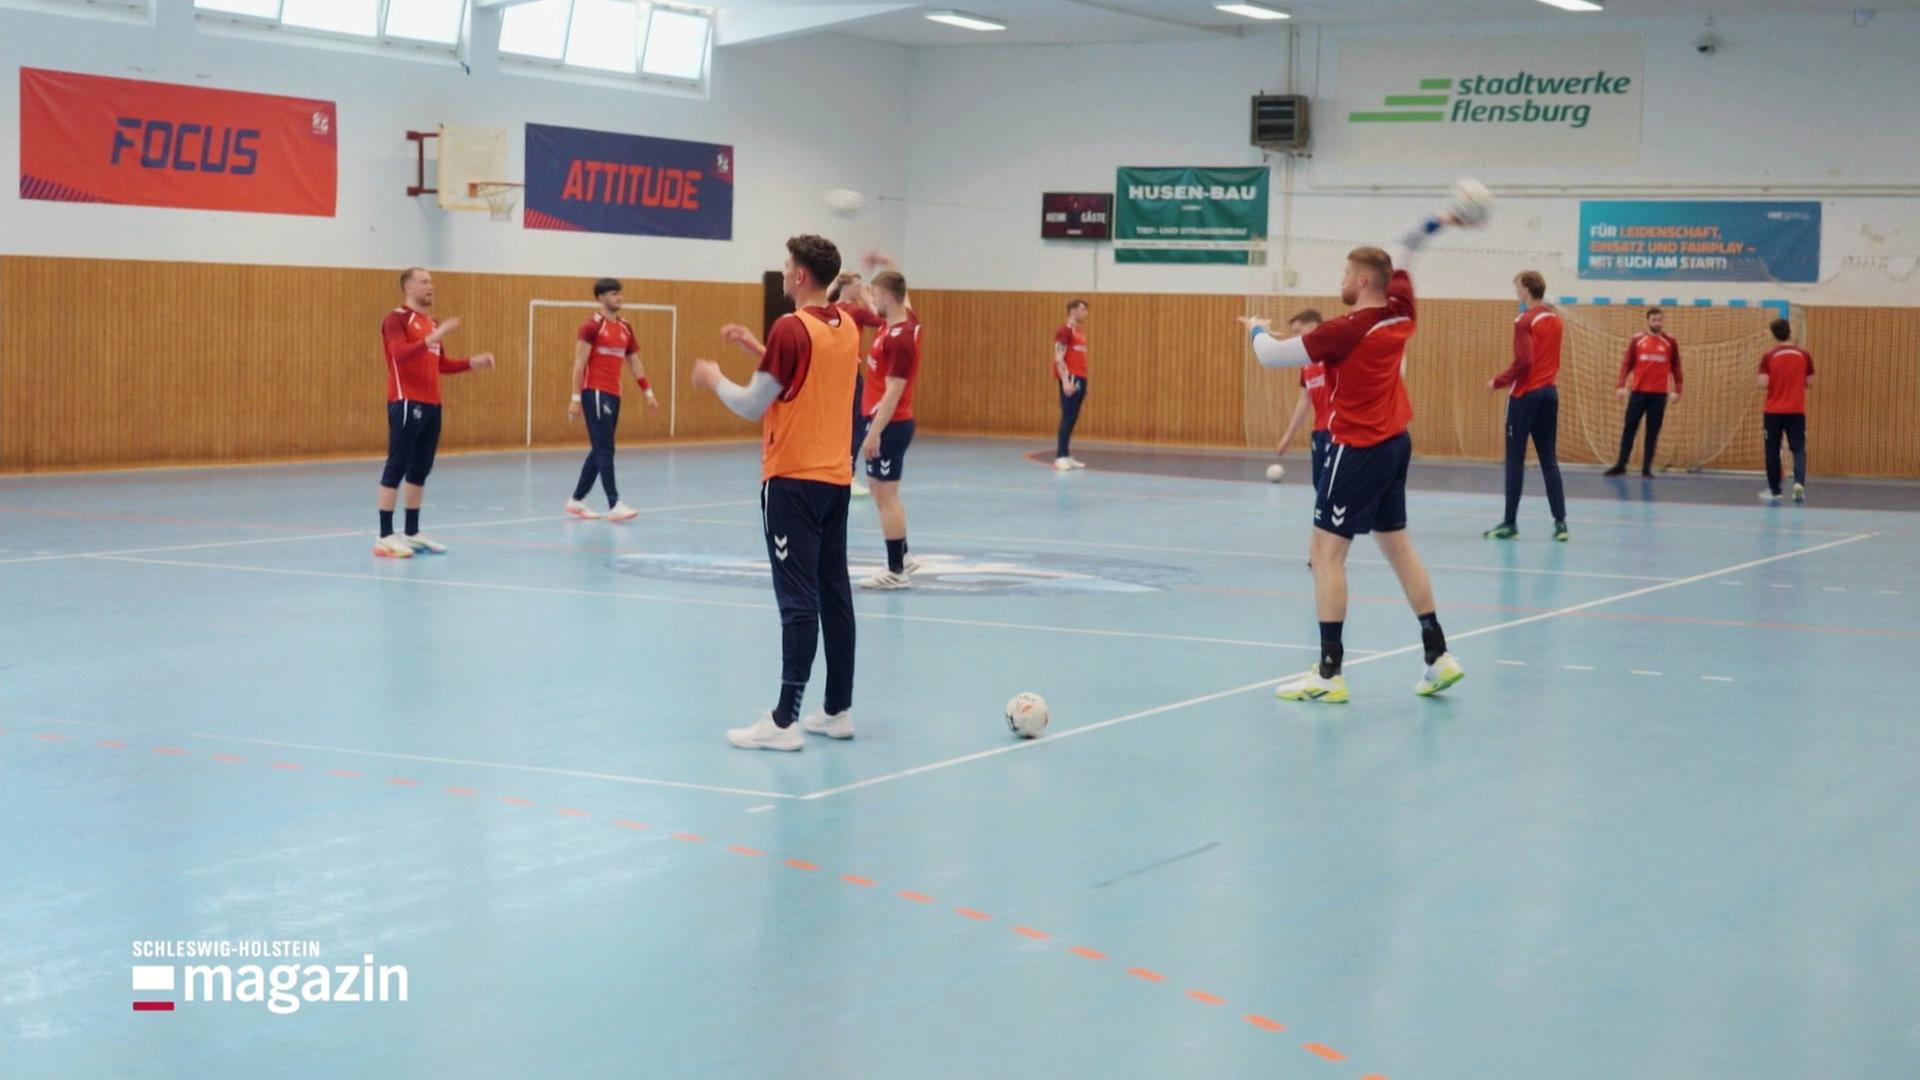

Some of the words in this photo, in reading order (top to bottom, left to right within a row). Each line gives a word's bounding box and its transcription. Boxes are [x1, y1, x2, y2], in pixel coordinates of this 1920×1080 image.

[1458, 71, 1631, 95] stadtwerke
[1451, 100, 1591, 128] flensburg
[111, 117, 260, 176] FOCUS
[561, 159, 703, 211] ATTITUDE
[1128, 185, 1257, 200] HUSEN-BAU
[1590, 223, 1617, 238] FÜR
[1616, 256, 1652, 269] EUCH
[1655, 256, 1677, 269] AM
